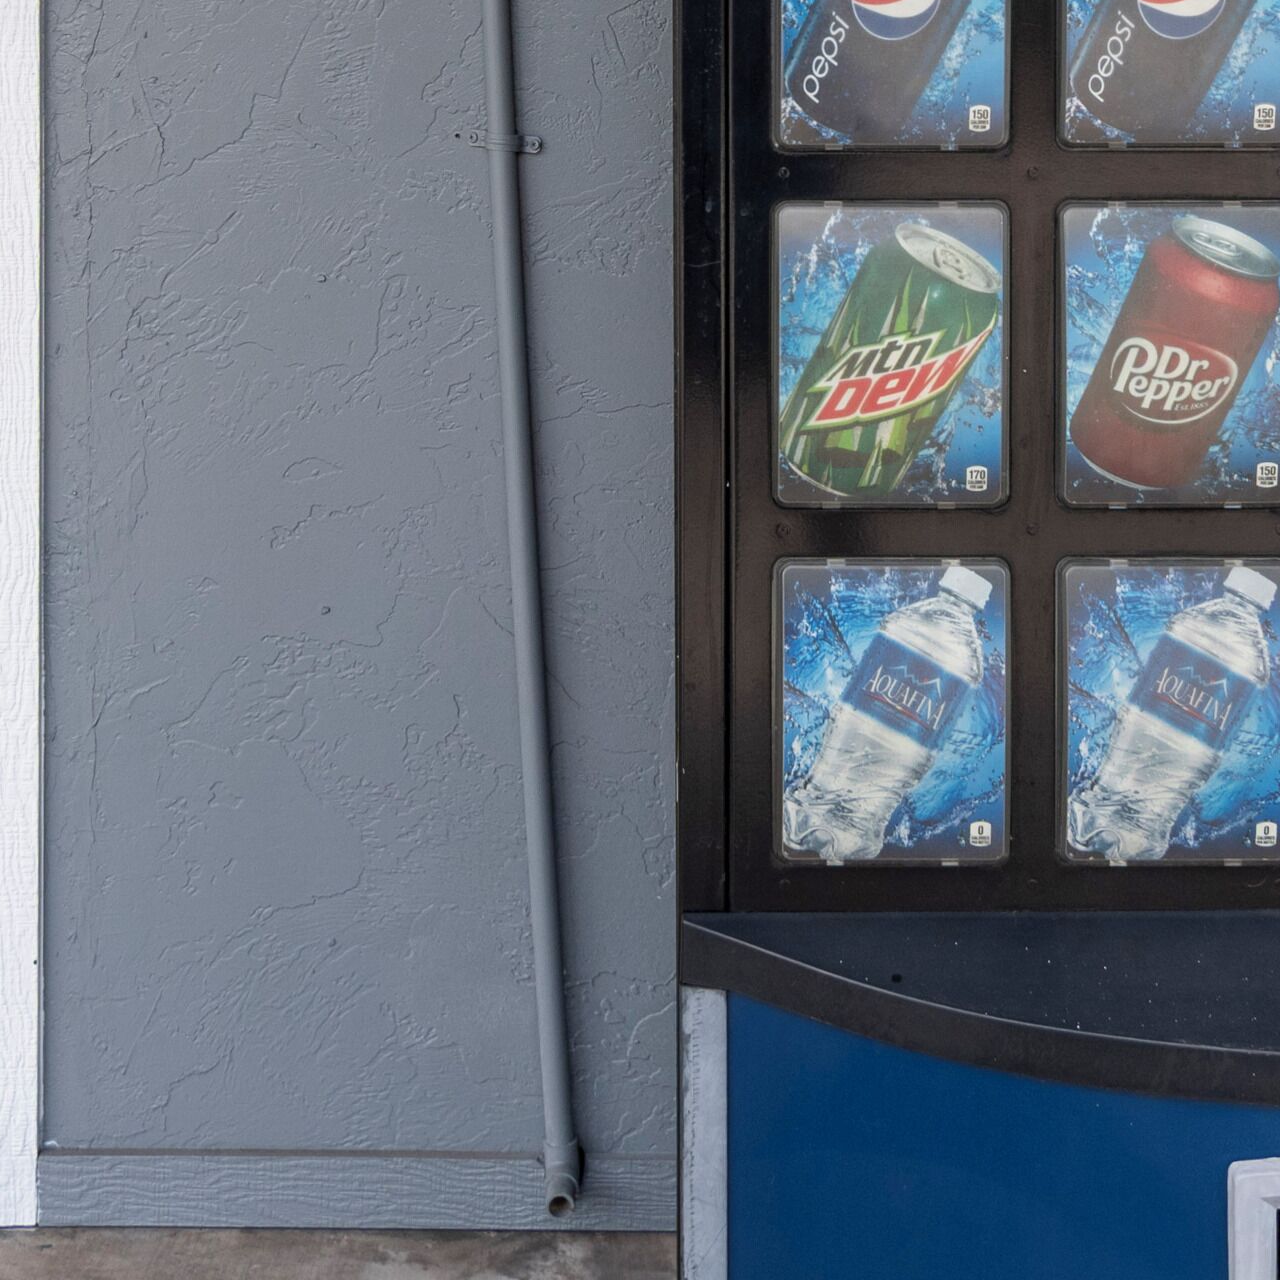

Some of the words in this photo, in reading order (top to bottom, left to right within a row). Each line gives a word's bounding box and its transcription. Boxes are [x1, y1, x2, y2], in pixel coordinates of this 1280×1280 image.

[803, 10, 850, 104] pepsi
[1088, 10, 1135, 103] pepsi
[972, 109, 989, 120] 150
[1257, 108, 1274, 119] 150
[825, 338, 933, 382] Mtn
[1111, 337, 1231, 411] Pepper
[1153, 345, 1210, 381] Dr
[968, 470, 986, 480] 170
[1260, 465, 1276, 476] 150
[862, 664, 946, 731] AQUAFINA
[1149, 666, 1233, 731] AQUAFINA
[977, 825, 984, 835] 0
[1263, 825, 1270, 835] 0
